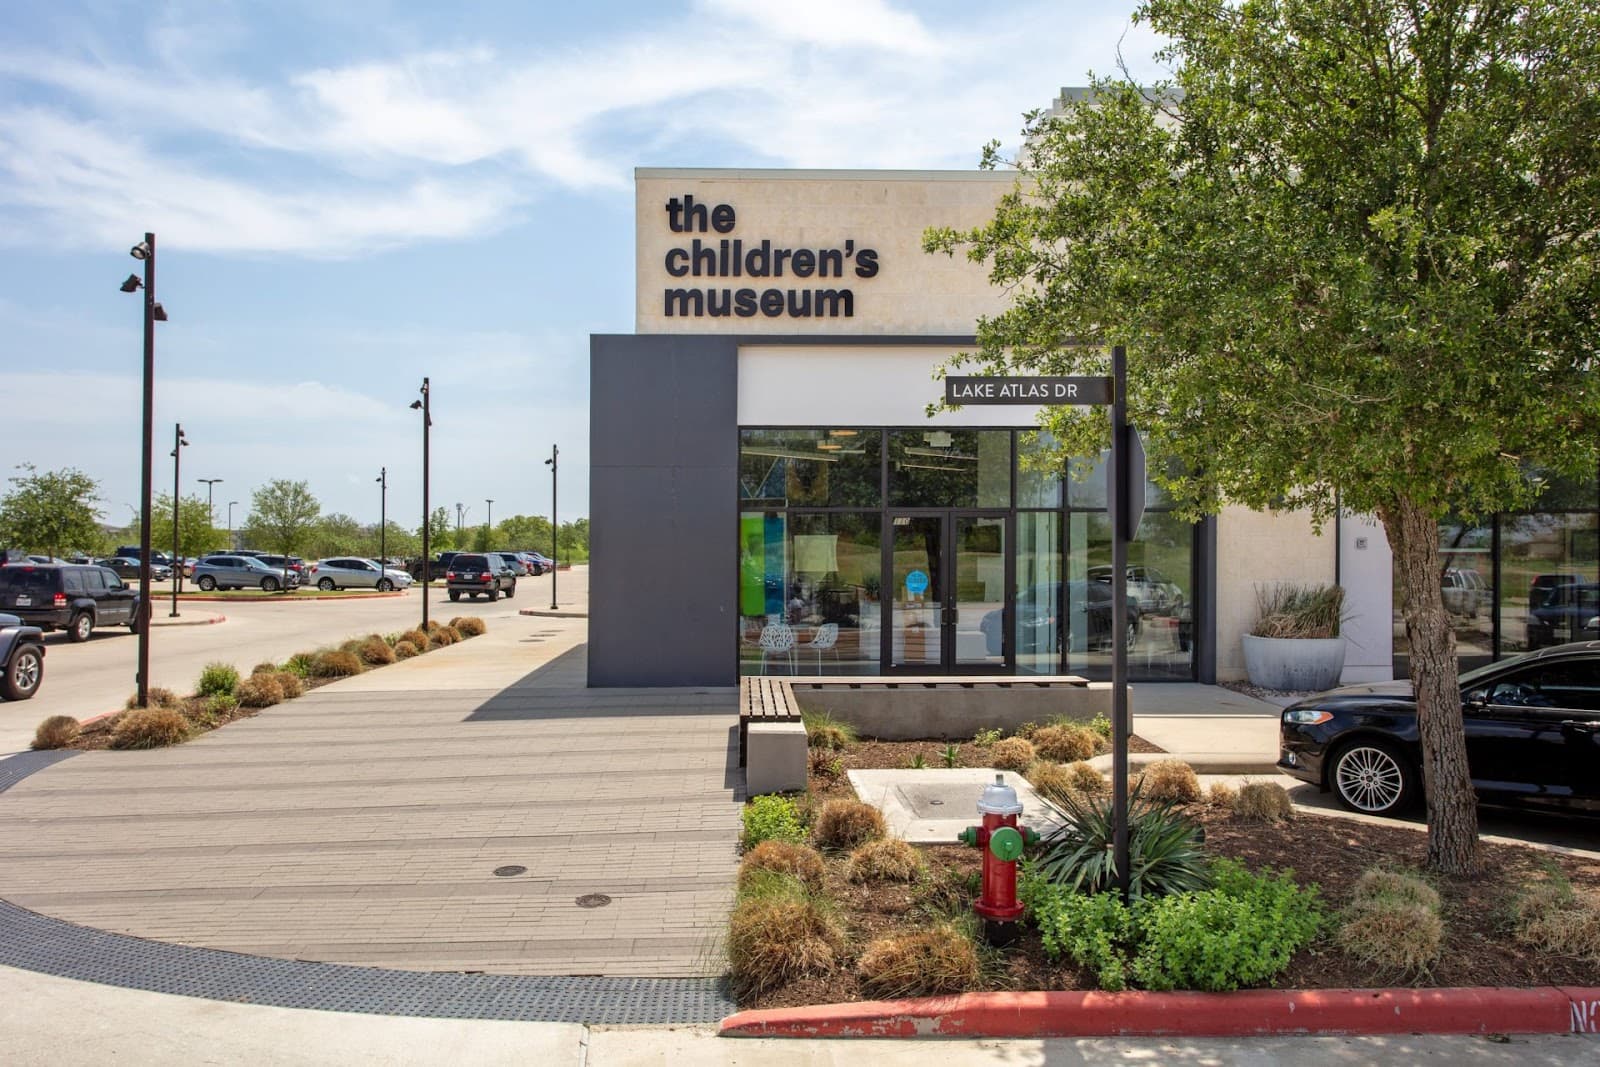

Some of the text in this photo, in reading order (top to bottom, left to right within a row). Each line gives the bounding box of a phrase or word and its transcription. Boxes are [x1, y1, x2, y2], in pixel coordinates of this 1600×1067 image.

[665, 194, 736, 233] the
[665, 239, 879, 278] children’s
[664, 288, 854, 317] museum
[952, 383, 1078, 398] LAKE ATLAS DR
